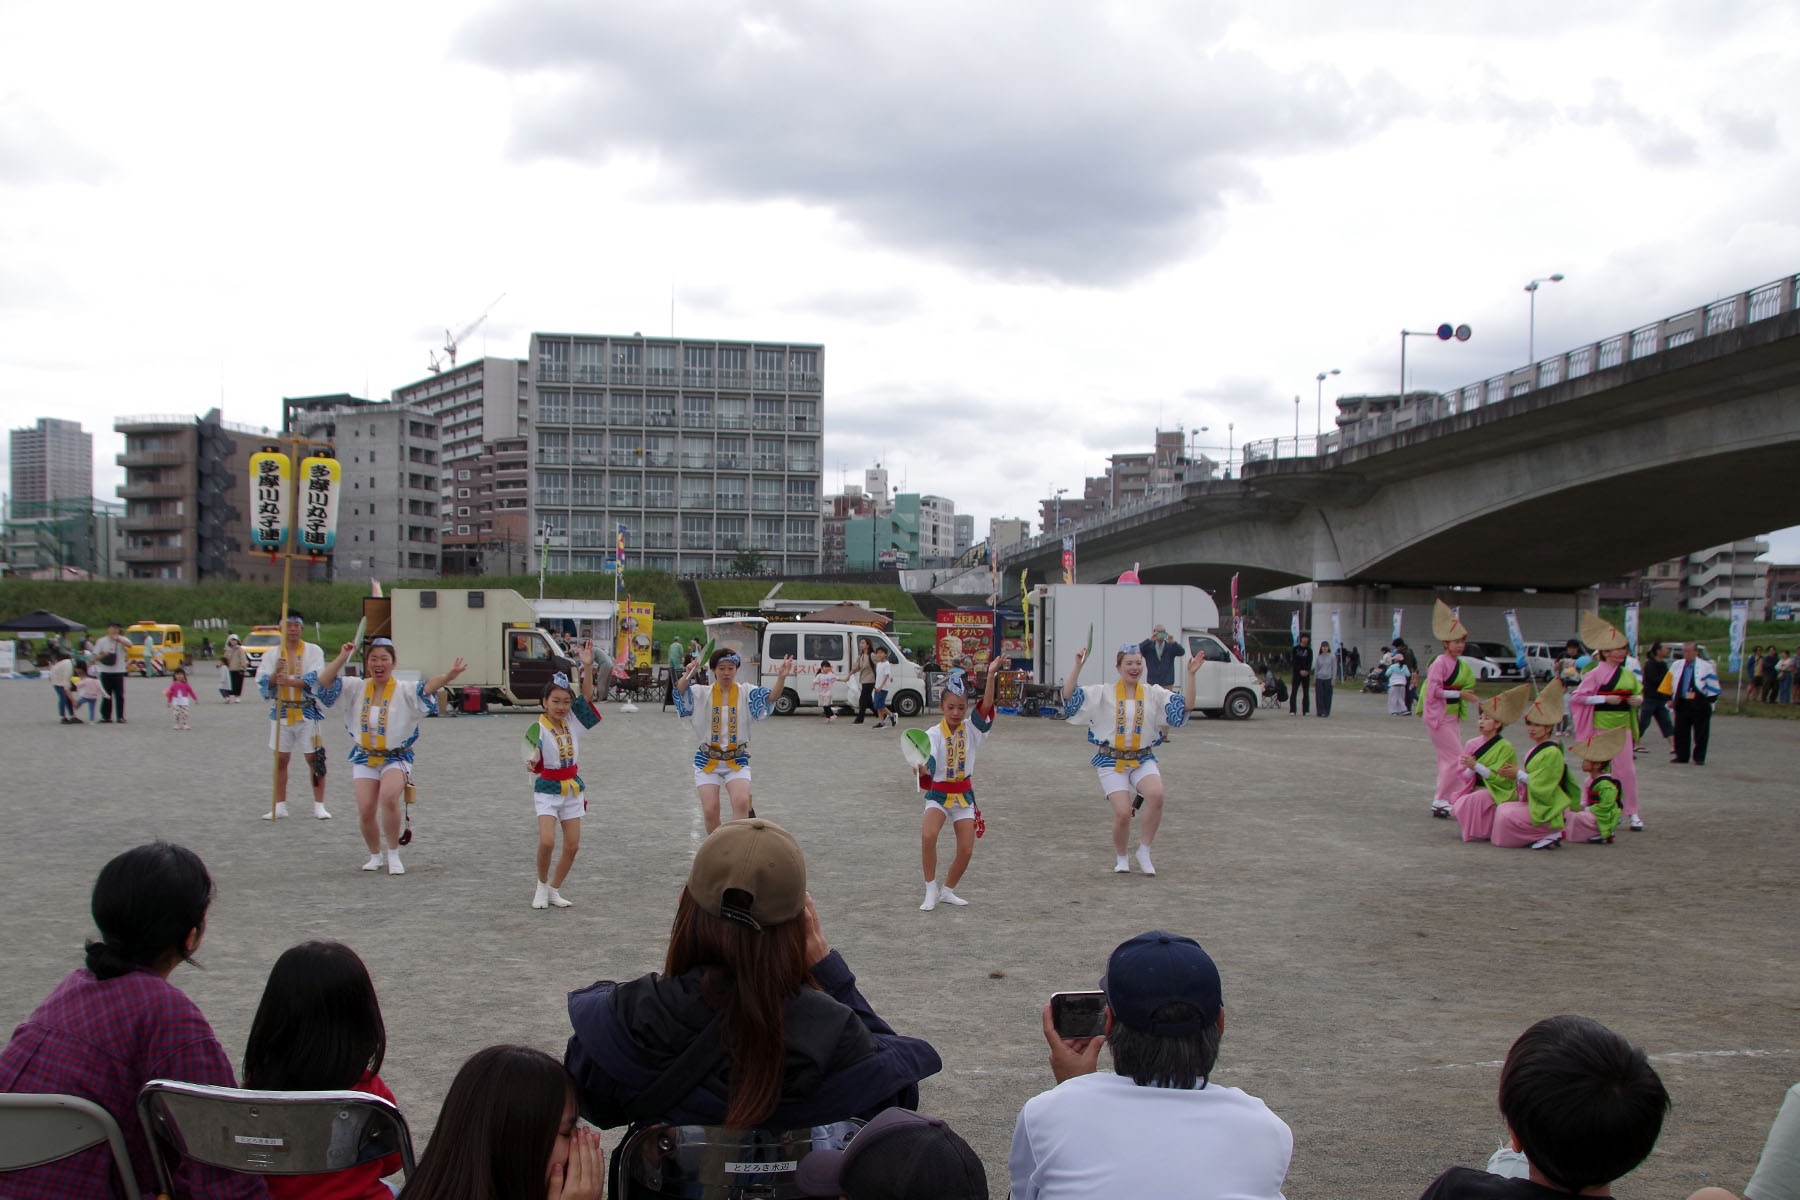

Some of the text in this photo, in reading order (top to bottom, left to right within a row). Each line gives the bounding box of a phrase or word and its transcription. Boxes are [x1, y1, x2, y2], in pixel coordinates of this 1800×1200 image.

[258, 460, 280, 541] 多摩川丸子連
[304, 464, 331, 545] 多摩川丸子連
[954, 615, 988, 624] KEBAB
[712, 706, 720, 743] まりこ連
[729, 706, 737, 743] まりこ連
[734, 1162, 790, 1172] とどろき水辺
